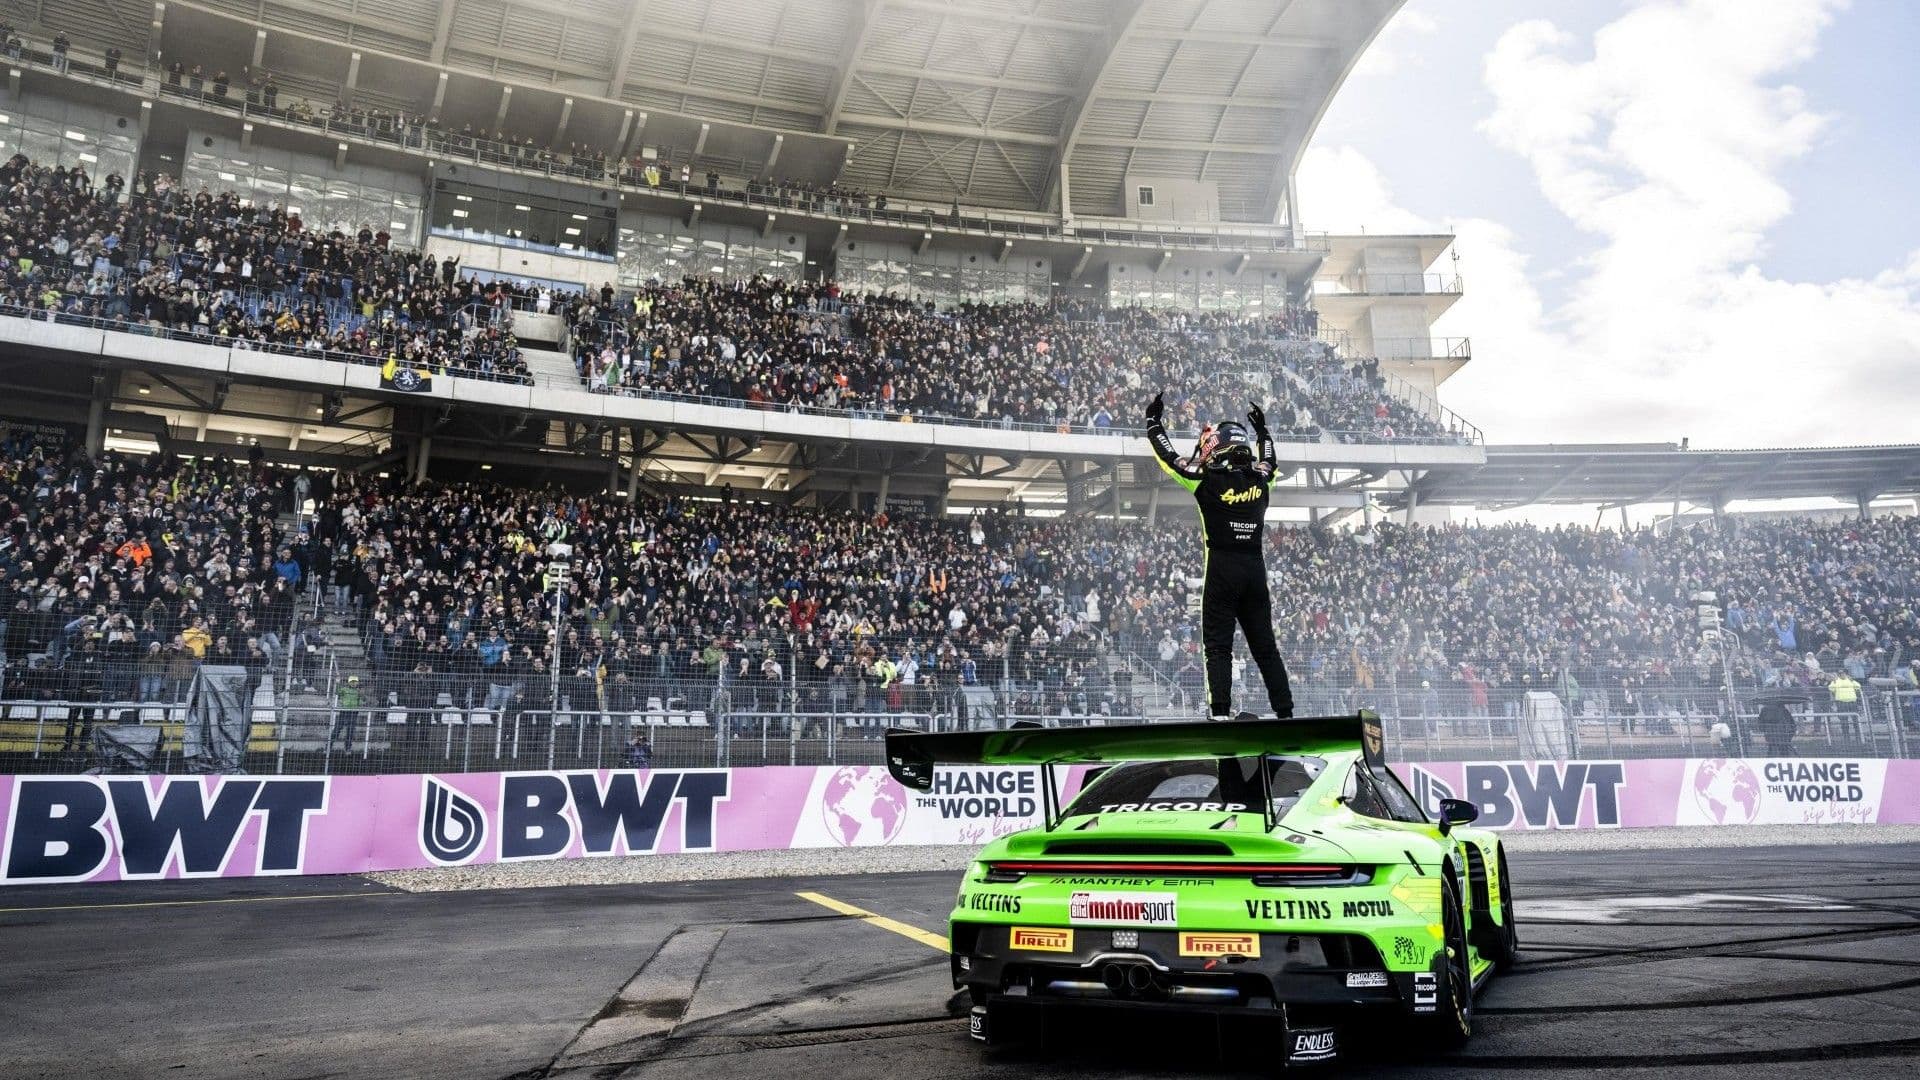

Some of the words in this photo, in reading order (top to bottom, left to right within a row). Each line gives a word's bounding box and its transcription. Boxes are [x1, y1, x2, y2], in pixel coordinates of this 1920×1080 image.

[1221, 485, 1262, 505] Grello
[1229, 521, 1257, 529] TRICORP
[1764, 763, 1861, 782] CHANGE
[933, 771, 1035, 794] HANGE
[1466, 764, 1624, 827] BWT
[1767, 785, 1782, 793] THE
[1784, 785, 1863, 802] WORLD
[501, 772, 728, 858] BWT
[916, 798, 936, 808] THE
[939, 797, 1036, 819] WORLD
[1101, 802, 1247, 813] TRICORP
[6, 781, 325, 878] BWT
[1070, 878, 1156, 887] MANTHEY
[1163, 879, 1214, 887] EMA
[971, 893, 1021, 914] VELTINS
[1245, 899, 1331, 919] VELTINS
[1343, 900, 1394, 918] MOTUL
[1015, 931, 1067, 948] PIRELLI
[1186, 936, 1252, 953] PIRELLI
[1295, 1032, 1334, 1050] ENDLESS
